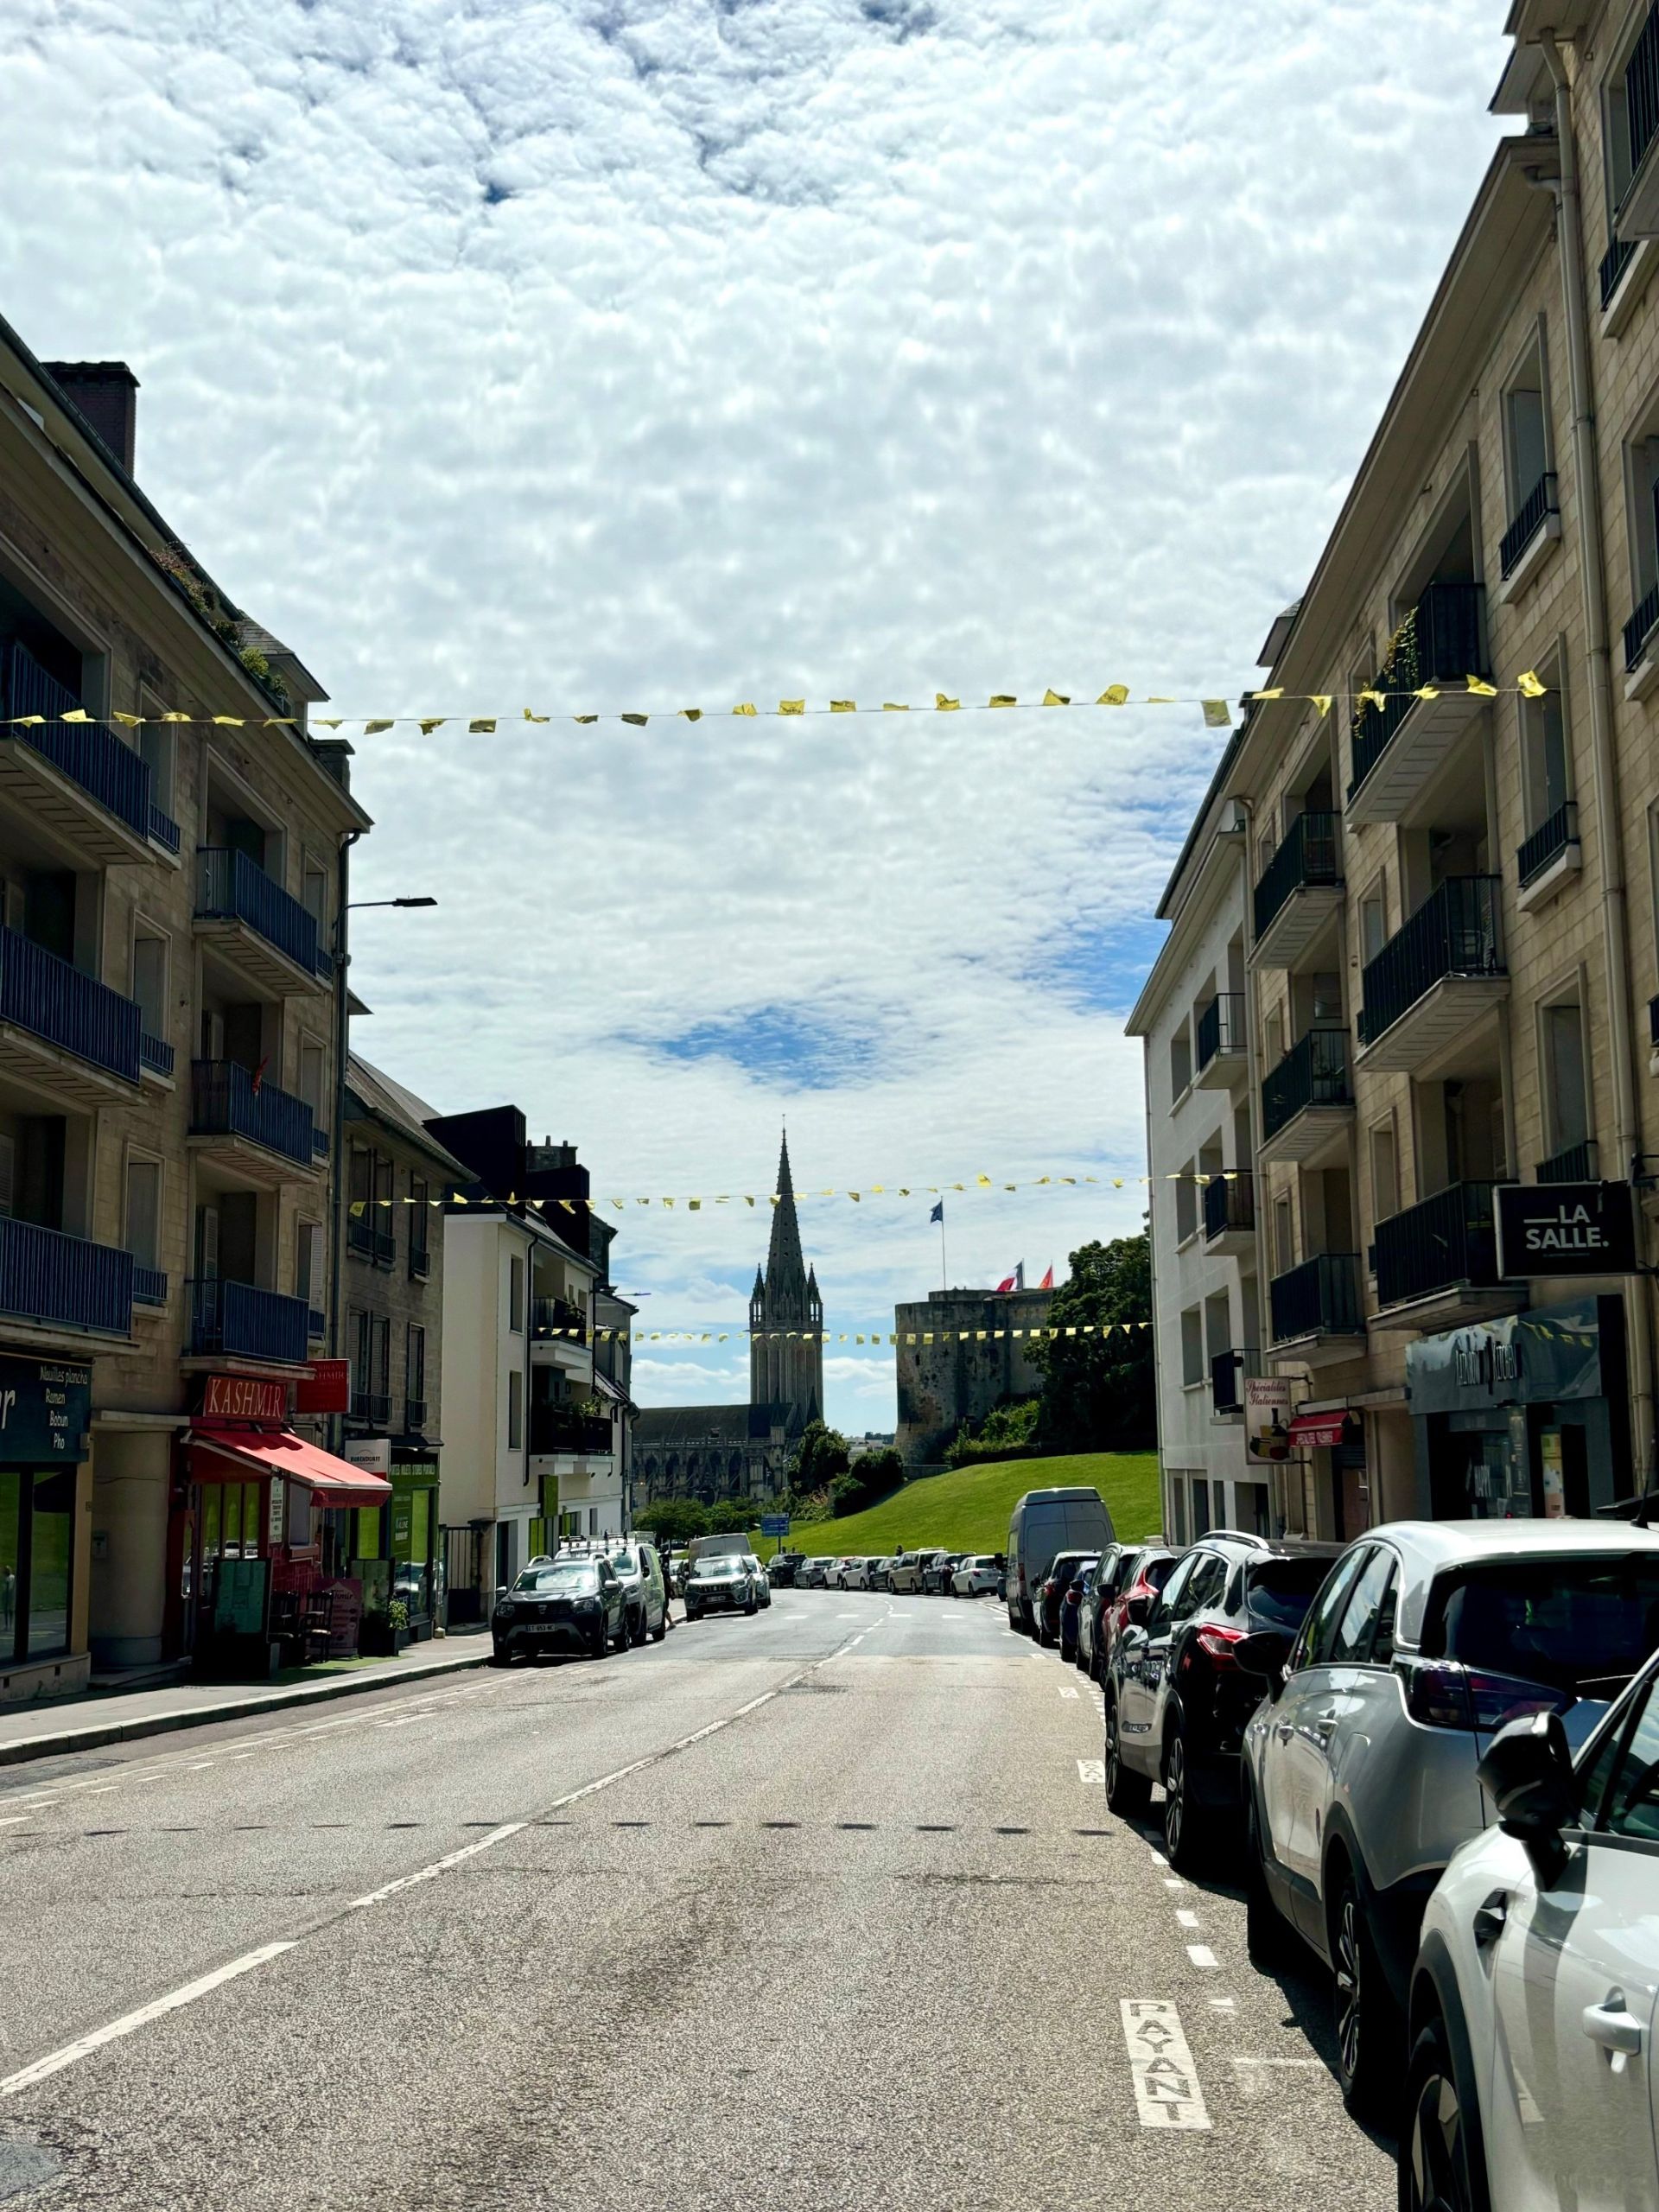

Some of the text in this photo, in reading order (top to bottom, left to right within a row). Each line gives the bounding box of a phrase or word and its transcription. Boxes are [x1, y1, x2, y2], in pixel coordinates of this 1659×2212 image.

[1559, 1205, 1591, 1224] LA
[1526, 1227, 1609, 1249] SALLE.
[208, 1378, 282, 1419] KASHMIR
[54, 1433, 65, 1449] Pho
[1129, 2003, 1196, 2121] PAYANT
